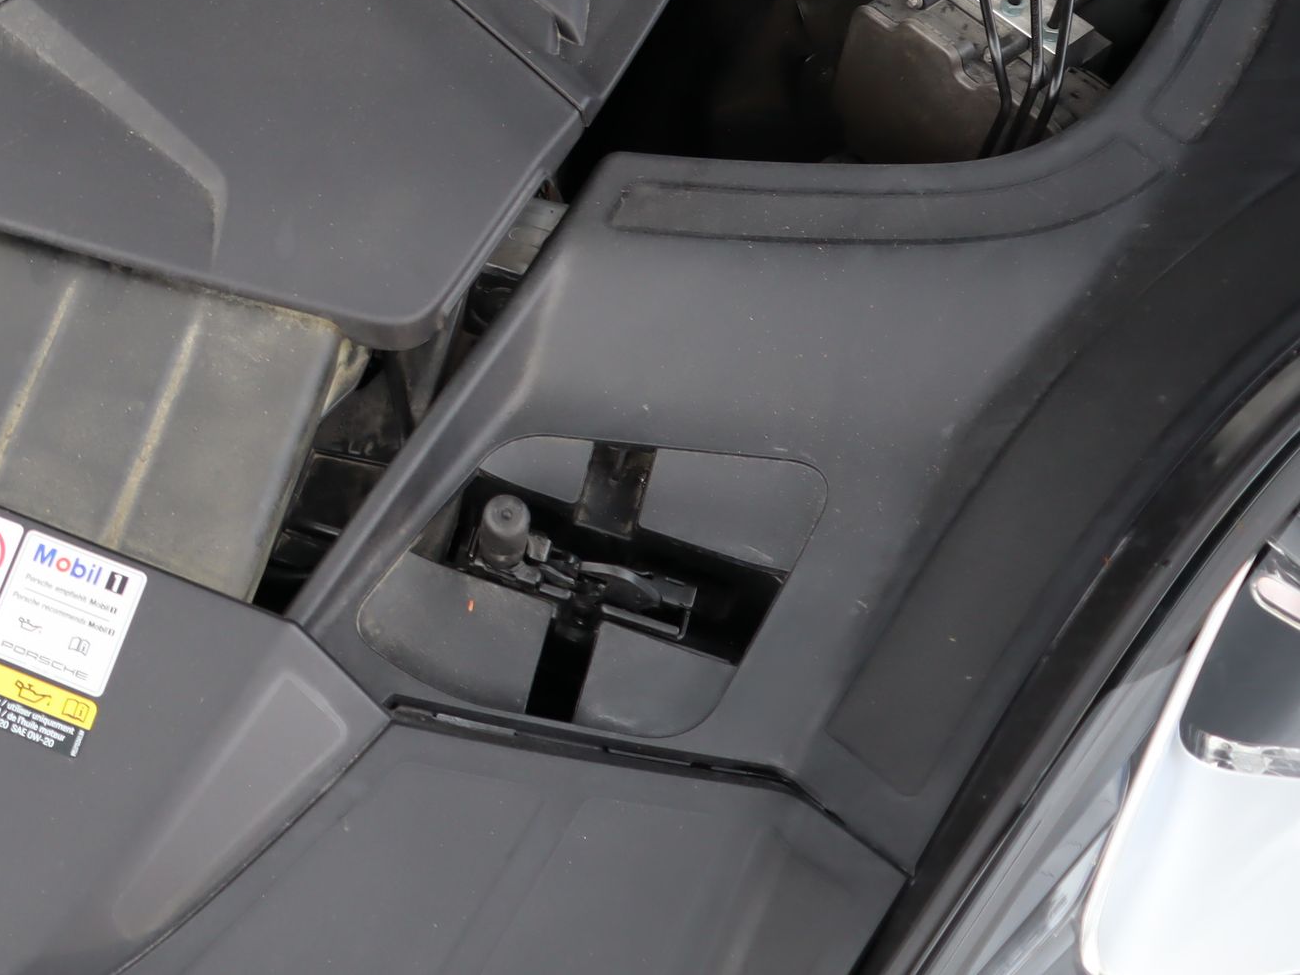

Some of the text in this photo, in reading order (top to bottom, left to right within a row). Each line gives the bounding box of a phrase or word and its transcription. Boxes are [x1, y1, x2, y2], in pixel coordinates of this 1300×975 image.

[33, 544, 126, 594] Mobil 1
[1, 641, 88, 680] PORSCHE
[7, 713, 17, 722] de
[39, 726, 65, 741] moteur
[10, 724, 27, 737] SAE
